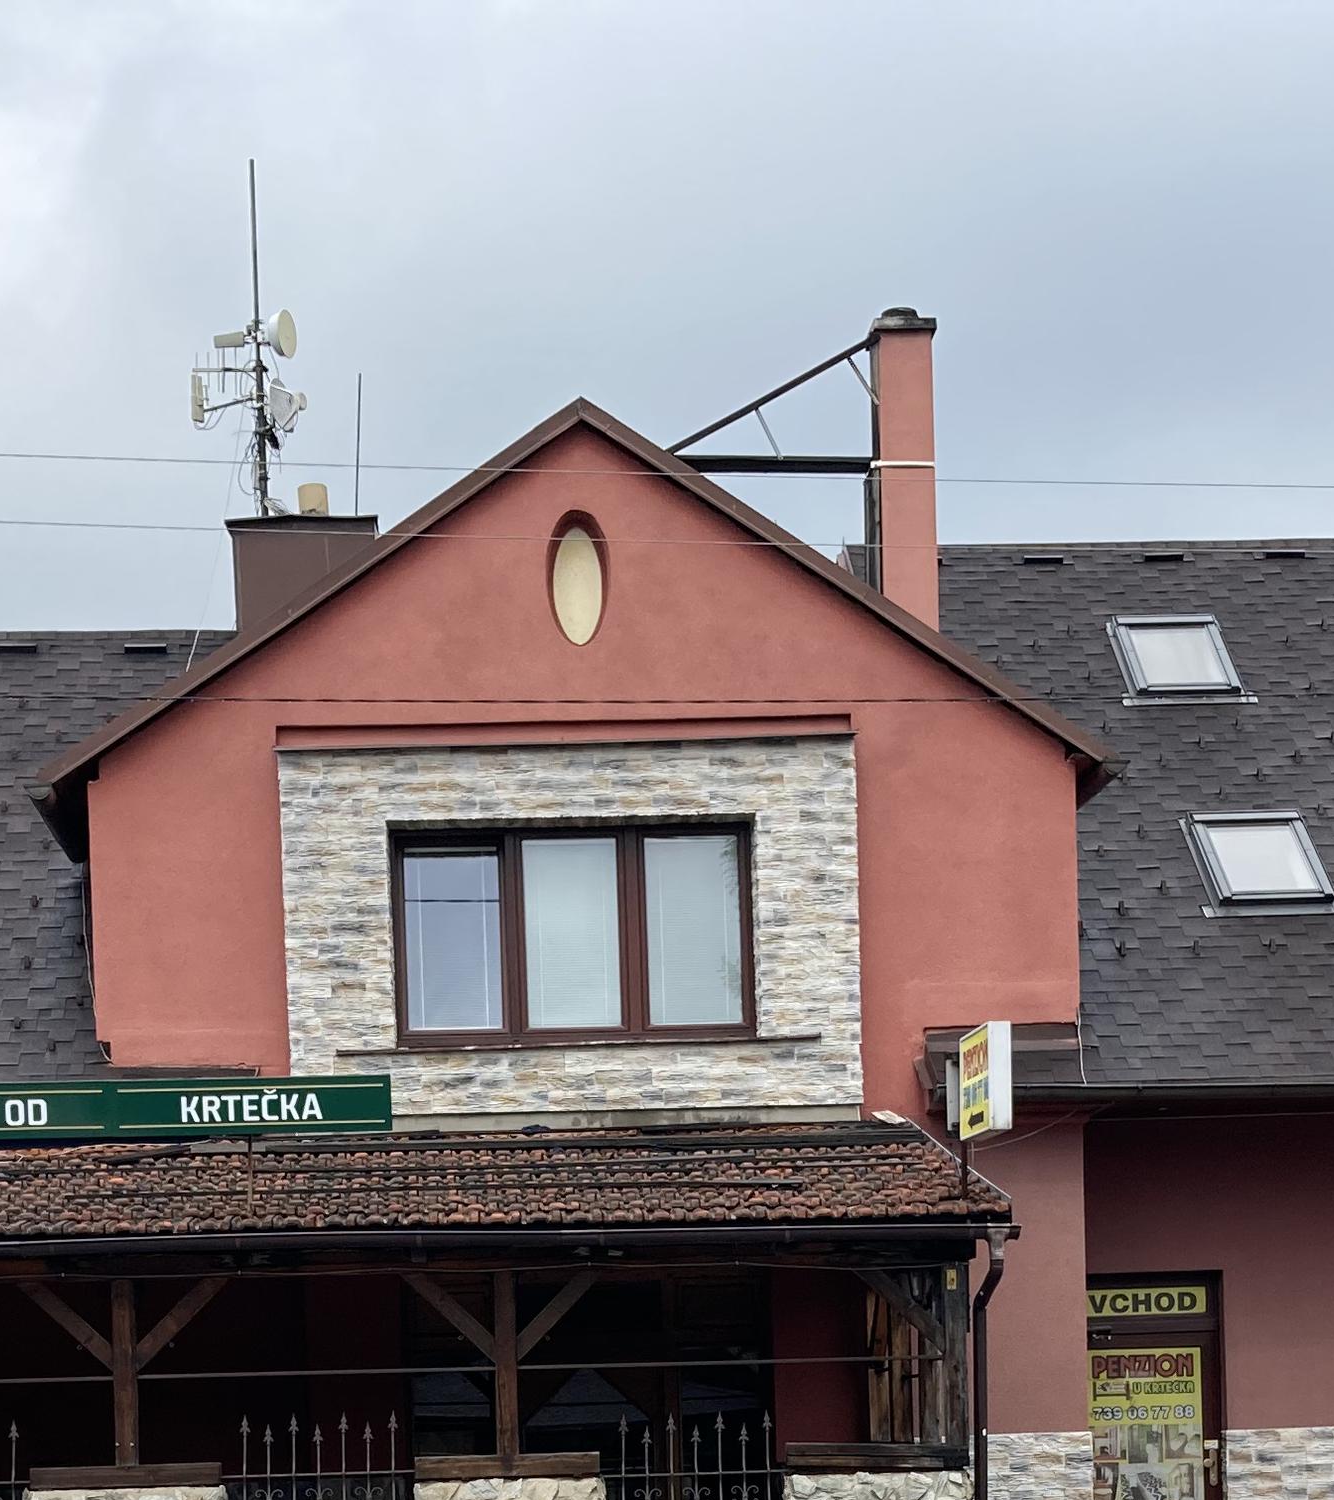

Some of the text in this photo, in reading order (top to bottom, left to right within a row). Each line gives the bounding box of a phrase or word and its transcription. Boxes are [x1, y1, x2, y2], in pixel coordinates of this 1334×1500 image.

[5, 1099, 48, 1127] OD
[180, 1089, 323, 1123] KRTEČKA
[1088, 1291, 1198, 1314] VCHOD
[1091, 1353, 1194, 1379] PENZION
[1132, 1380, 1195, 1394] U KRTEČKA
[1092, 1405, 1195, 1421] 739 06 77 88
